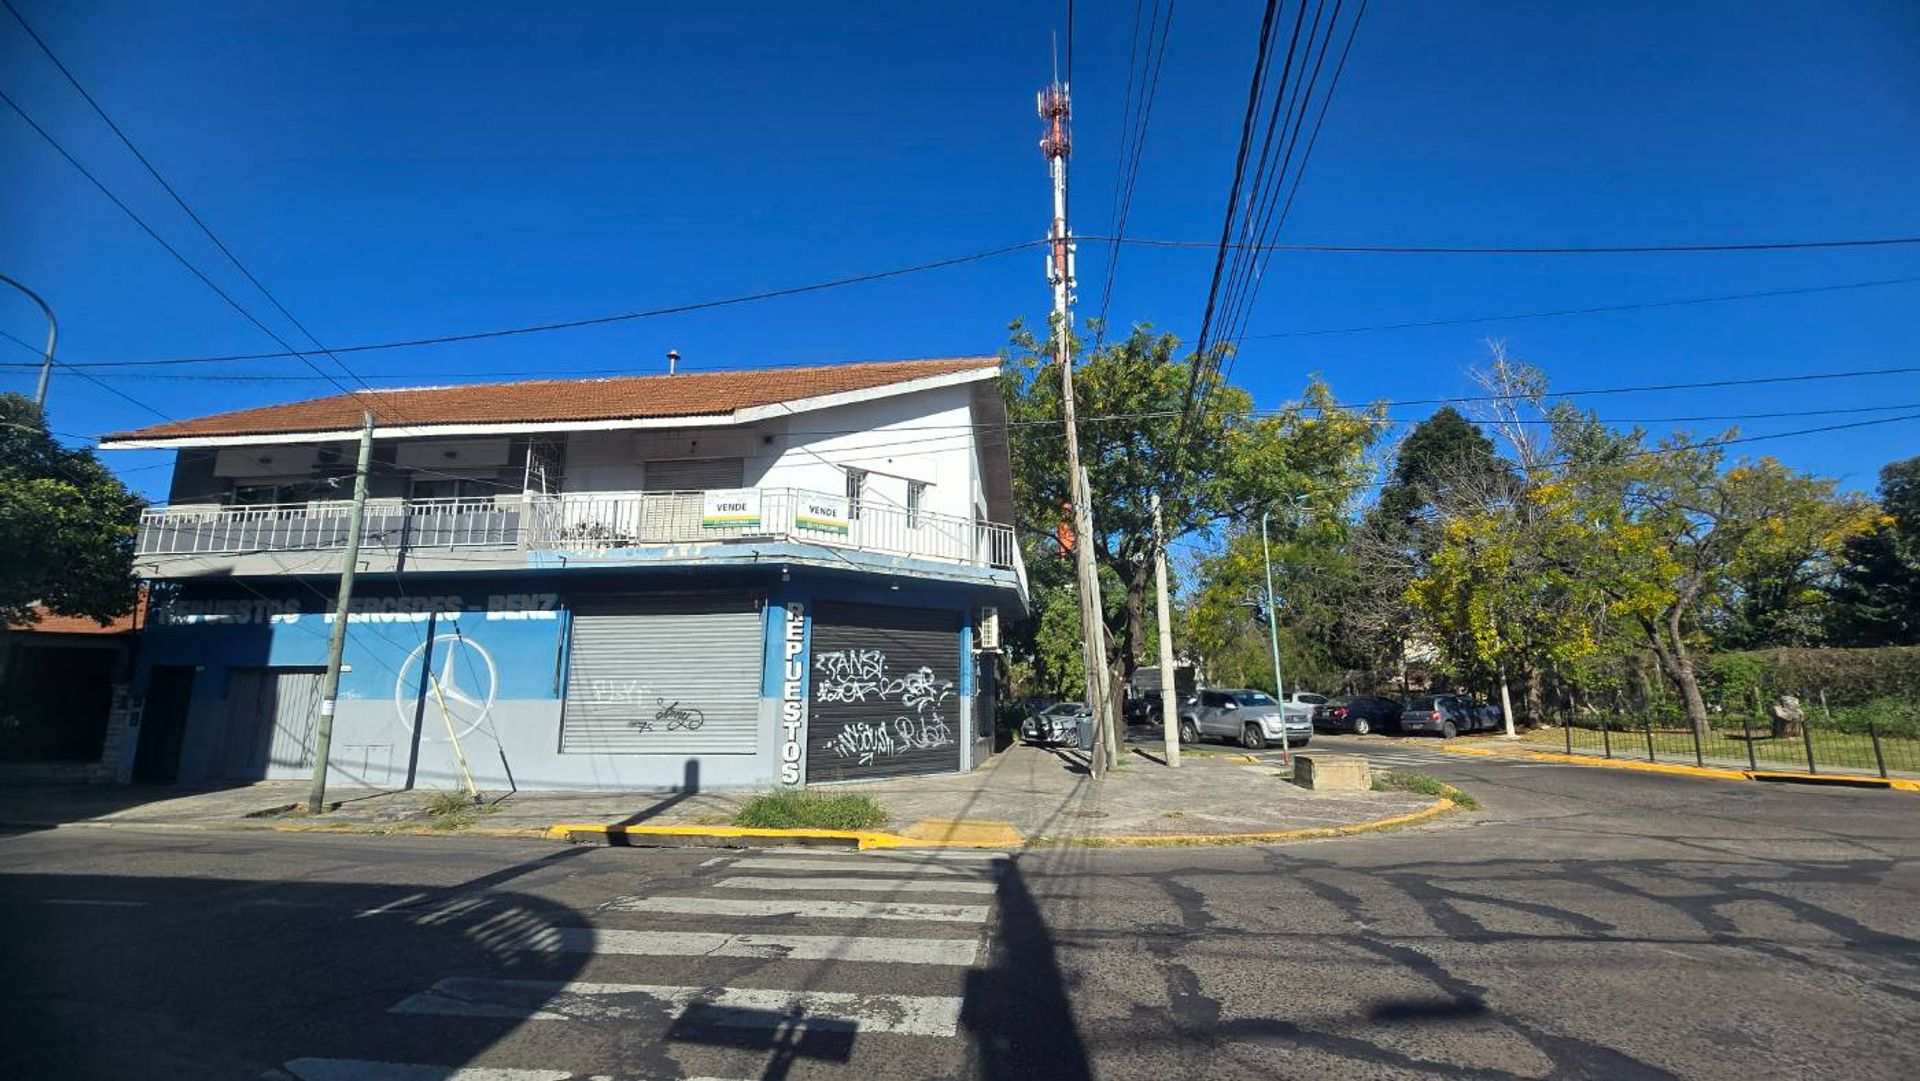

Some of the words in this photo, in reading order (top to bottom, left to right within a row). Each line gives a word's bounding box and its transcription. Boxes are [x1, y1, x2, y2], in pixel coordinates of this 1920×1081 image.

[716, 502, 748, 512] VENDE
[809, 504, 838, 518] VENDE
[486, 592, 559, 621] BENZ
[781, 602, 805, 785] REPUESTOS
